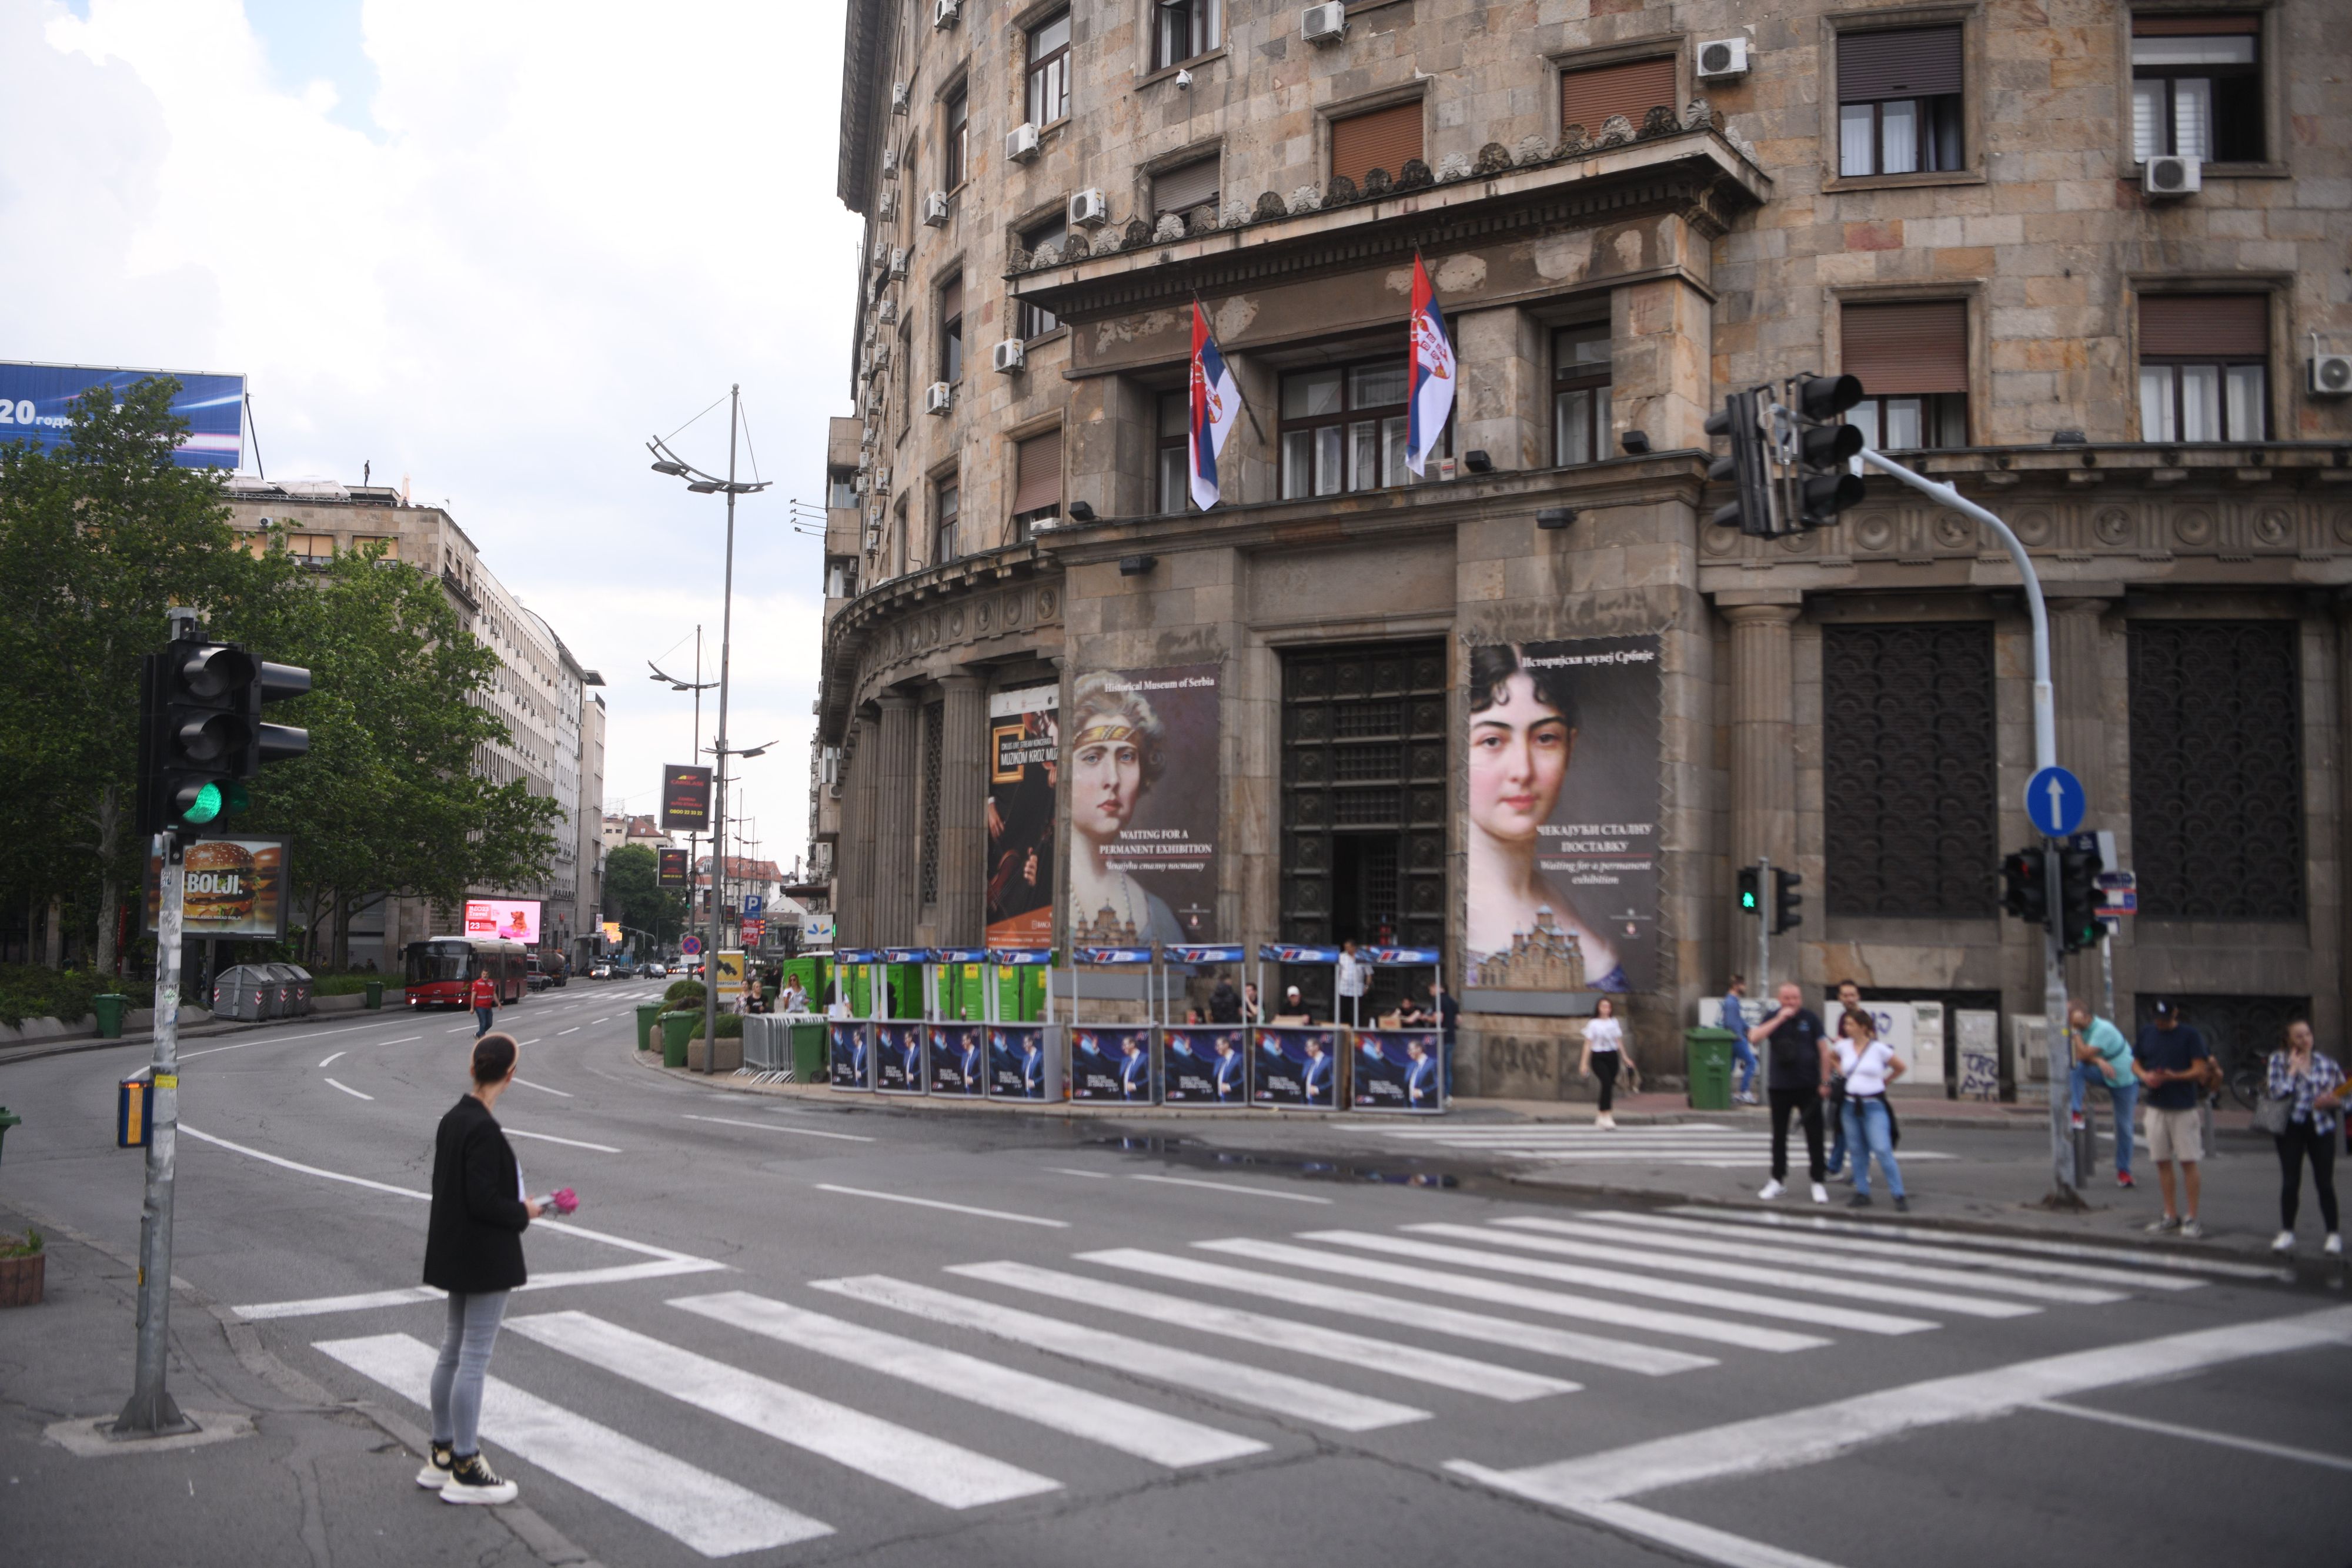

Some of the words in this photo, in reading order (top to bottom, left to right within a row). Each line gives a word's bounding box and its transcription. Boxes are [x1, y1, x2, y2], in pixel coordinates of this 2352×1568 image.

[36, 416, 90, 429] годи
[1584, 651, 1613, 666] музеј
[1615, 649, 1655, 664] Србије
[1105, 681, 1142, 693] Historical
[1144, 680, 1177, 690] Museum
[1178, 678, 1188, 688] of
[1189, 677, 1214, 687] Serbia
[1020, 740, 1033, 748] STREAM
[1001, 751, 1027, 765] MUZIKOM
[1029, 748, 1045, 763] KROZ
[1120, 830, 1160, 840] WAITING
[1161, 830, 1180, 840] FOR
[1182, 830, 1188, 839] A
[1601, 824, 1653, 835] СТАЛНУ
[1100, 844, 1155, 854] PERMANENT
[1156, 844, 1212, 854] EXHIBITION
[1561, 841, 1629, 852] ПОСТАВКУ
[1540, 860, 1576, 873] Waiting
[1576, 860, 1590, 873] for
[1598, 861, 1651, 873] permanent
[188, 874, 243, 894] BOLJI.
[1571, 874, 1619, 884] exhibition
[748, 897, 759, 910] P
